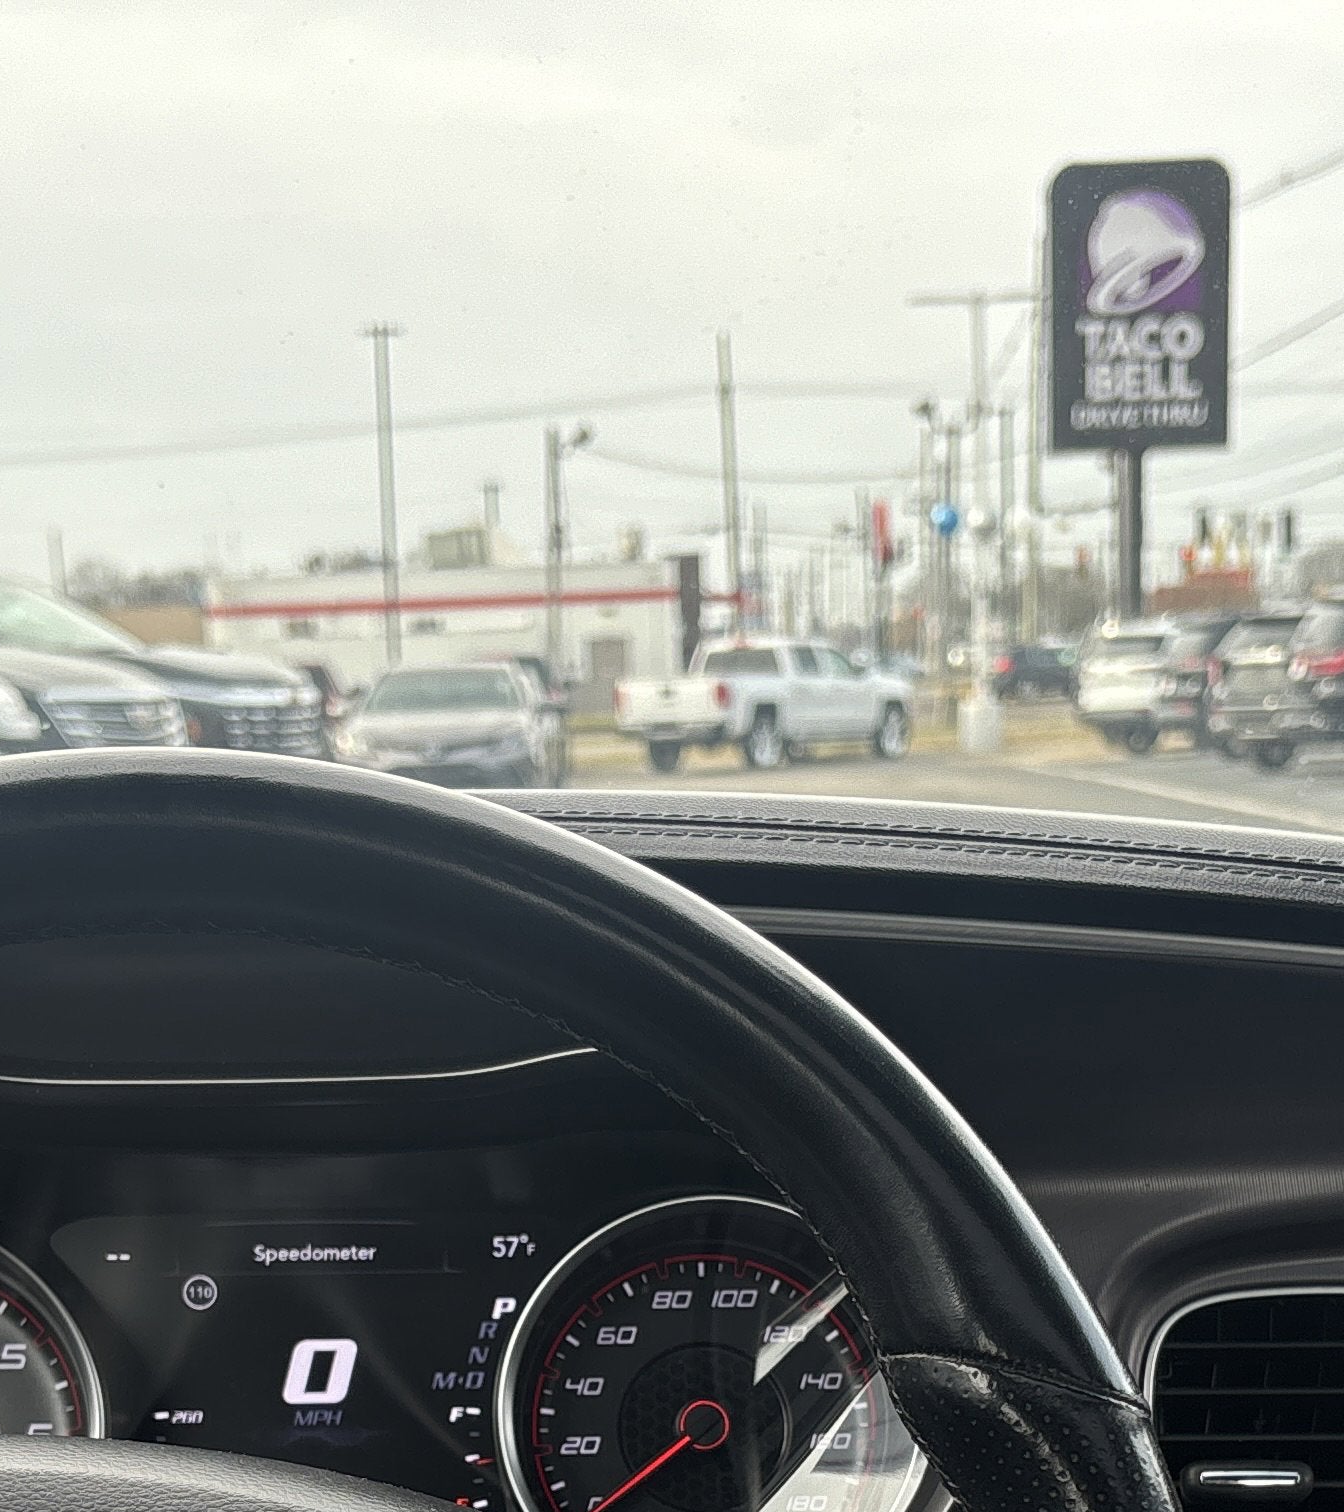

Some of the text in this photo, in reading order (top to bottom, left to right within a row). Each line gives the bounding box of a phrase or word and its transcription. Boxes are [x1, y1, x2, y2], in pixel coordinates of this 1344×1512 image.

[1075, 312, 1206, 361] TACO
[1083, 360, 1204, 401] BELL
[253, 1244, 377, 1265] Speedometer
[188, 1286, 213, 1299] 110
[651, 1290, 692, 1310] 80
[711, 1289, 758, 1310] 100
[492, 1297, 517, 1320] P
[478, 1321, 498, 1340] R
[596, 1326, 637, 1346] 60
[763, 1326, 808, 1344] 120
[468, 1346, 490, 1365] N
[282, 1338, 358, 1405] 0
[799, 1372, 843, 1391] 140
[565, 1377, 604, 1397] 40
[294, 1410, 343, 1427] MPH
[560, 1436, 601, 1456] 20
[785, 1495, 828, 1512] 180
